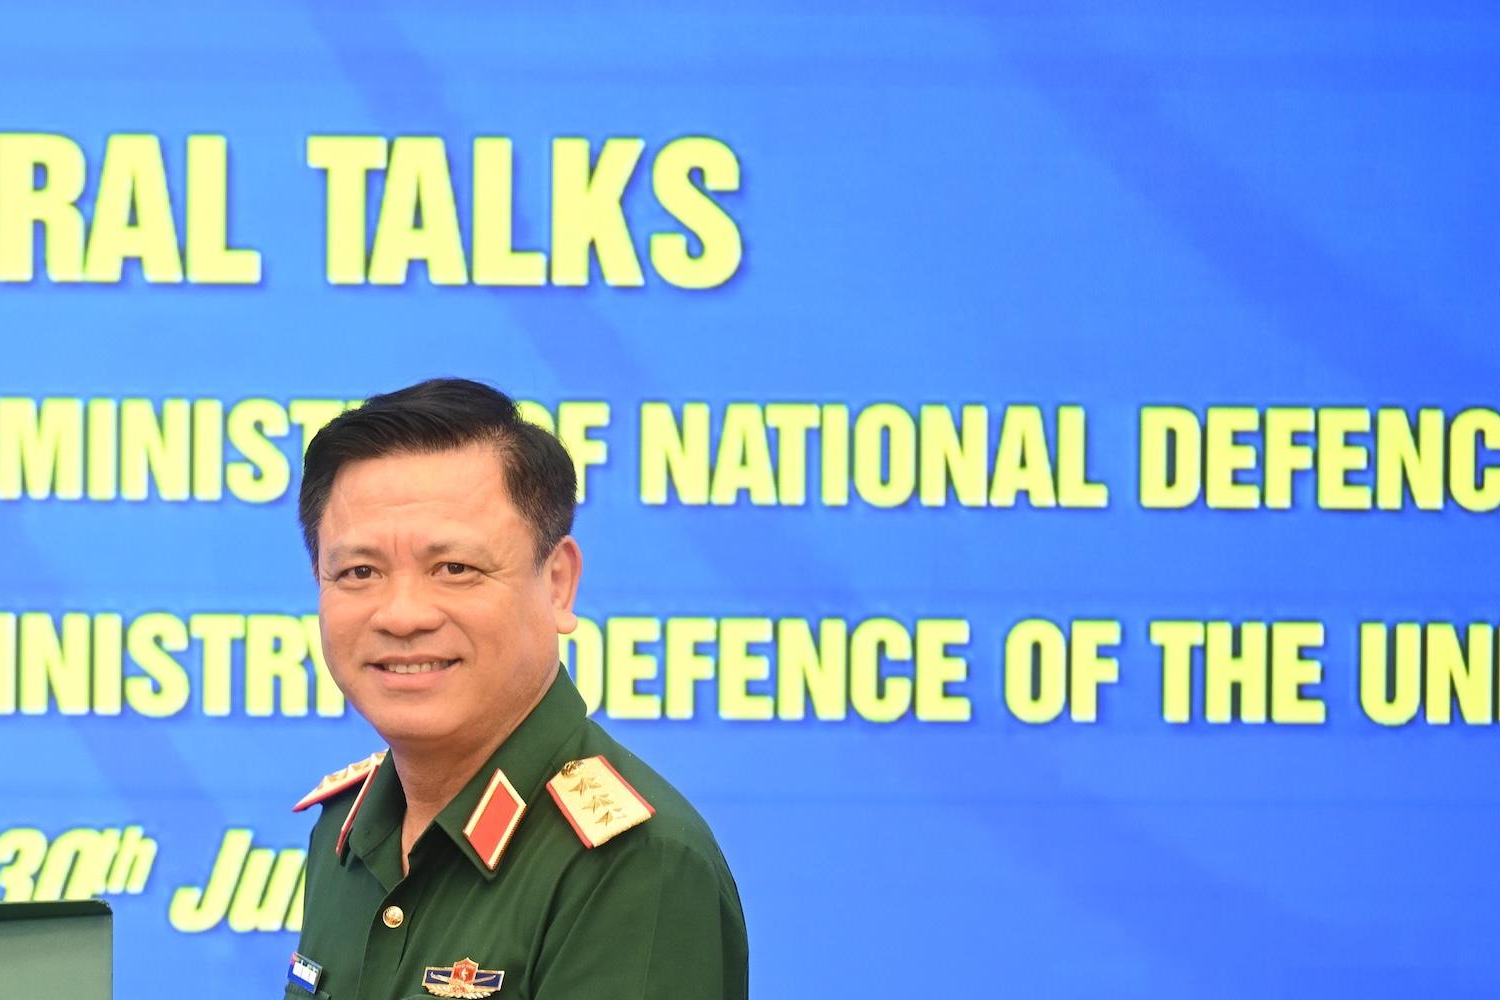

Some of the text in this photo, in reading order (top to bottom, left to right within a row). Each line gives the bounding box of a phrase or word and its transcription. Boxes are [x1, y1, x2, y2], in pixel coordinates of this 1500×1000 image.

[307, 134, 743, 290] TALKS
[515, 401, 611, 504] F
[640, 402, 1109, 508] NATIONAL
[1140, 406, 1500, 512] DEFENC
[1005, 619, 1121, 724] OF
[1150, 621, 1327, 725] THE
[1360, 622, 1500, 726] UN
